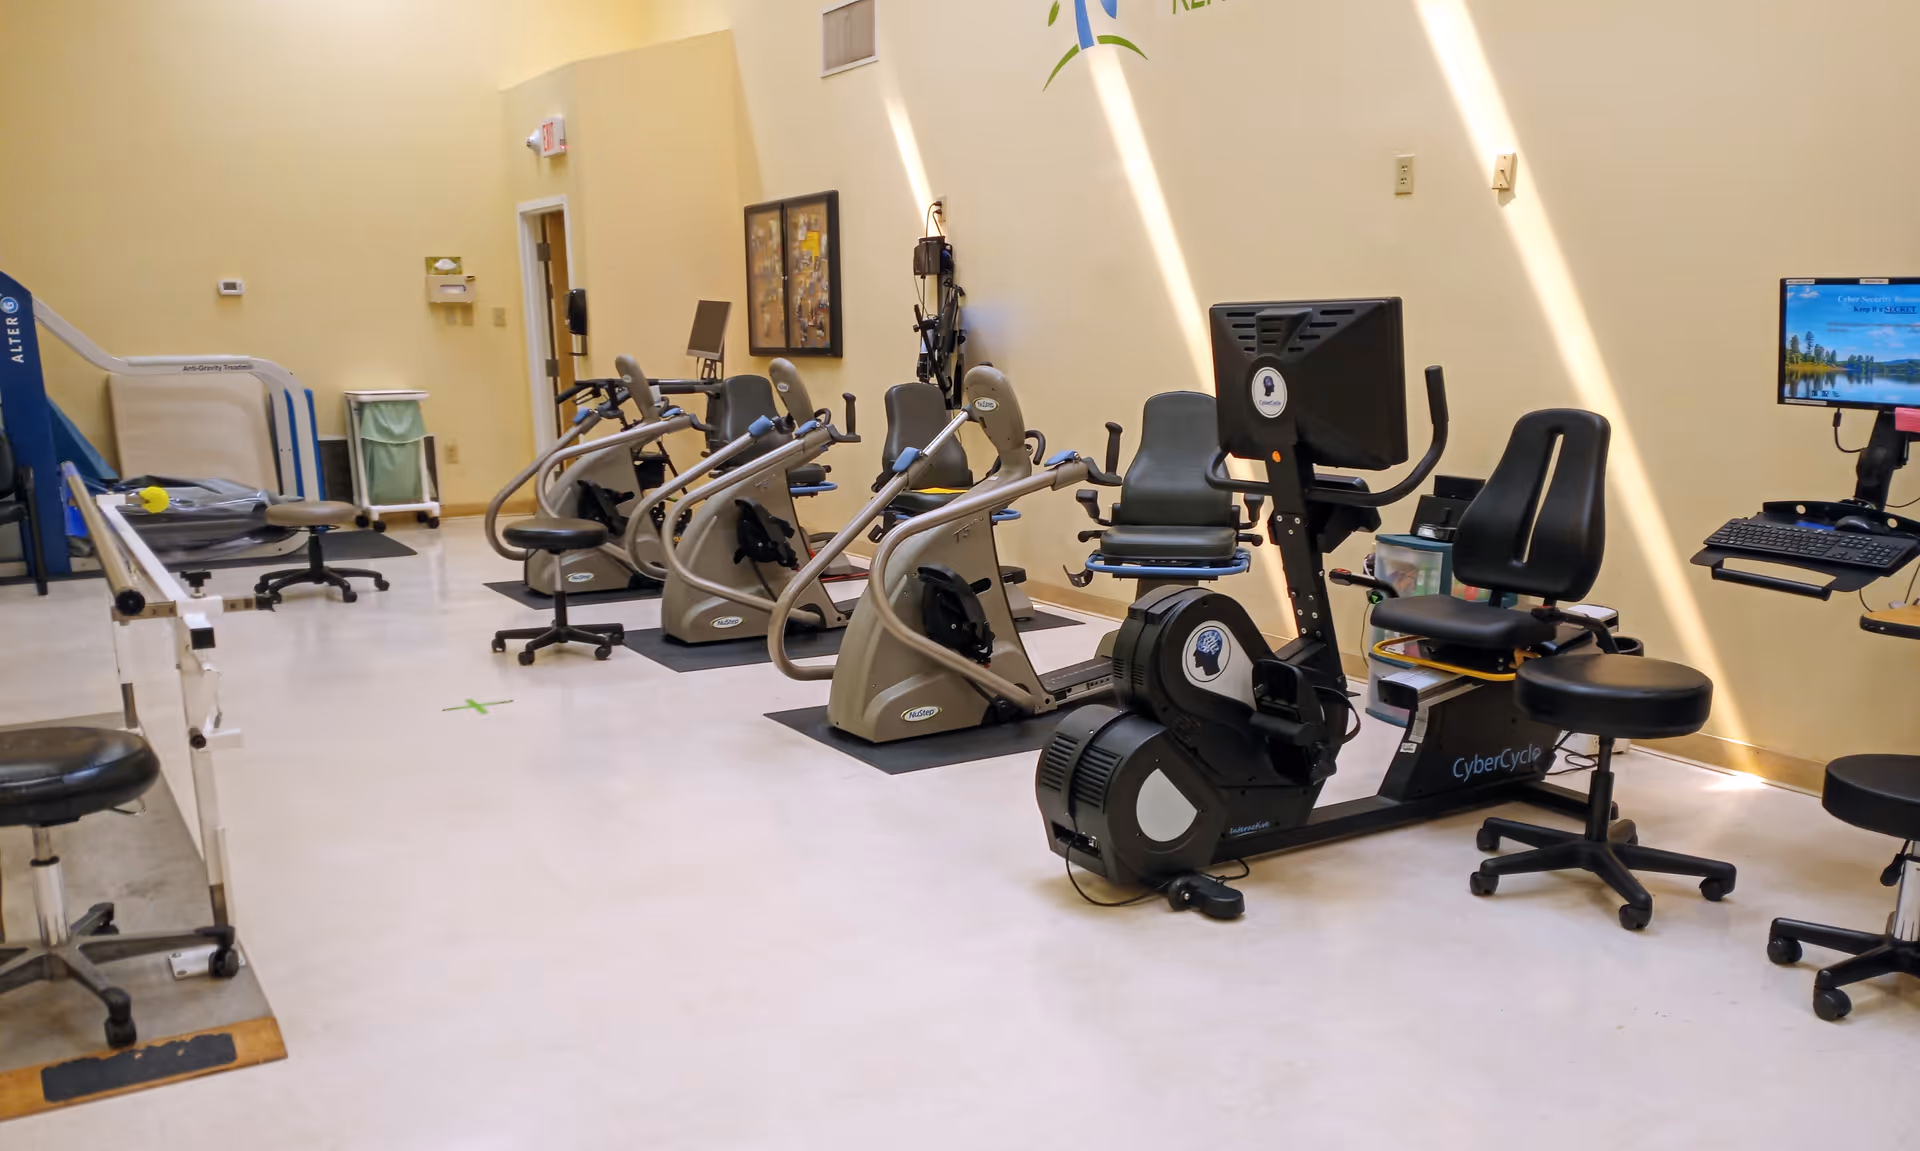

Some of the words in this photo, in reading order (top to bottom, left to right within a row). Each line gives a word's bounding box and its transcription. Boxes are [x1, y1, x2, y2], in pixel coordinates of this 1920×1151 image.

[5, 317, 25, 363] ALTER
[908, 709, 935, 719] NuStep
[1453, 744, 1541, 782] CyberCycle
